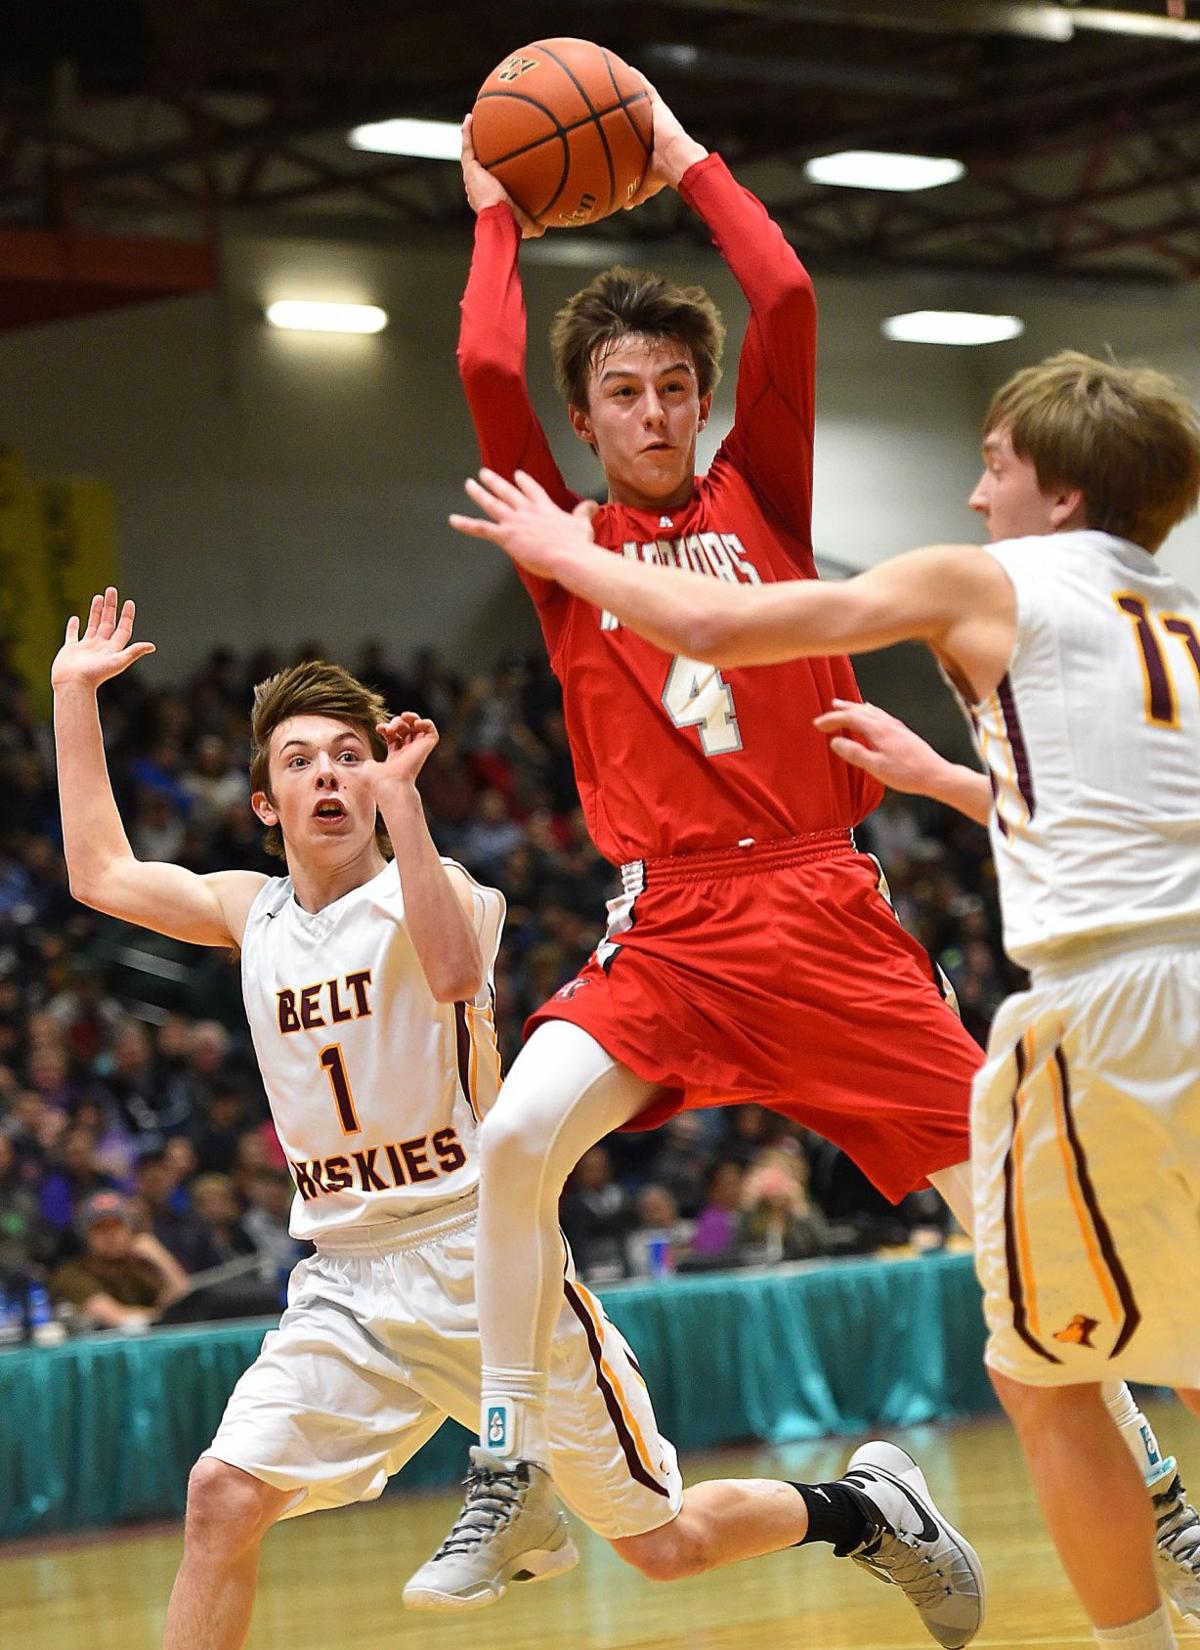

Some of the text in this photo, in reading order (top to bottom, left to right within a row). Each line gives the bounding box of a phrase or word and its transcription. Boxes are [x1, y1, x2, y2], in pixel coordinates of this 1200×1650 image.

[661, 654, 743, 757] 4
[276, 968, 373, 1036] BELT
[318, 1042, 362, 1137] 1
